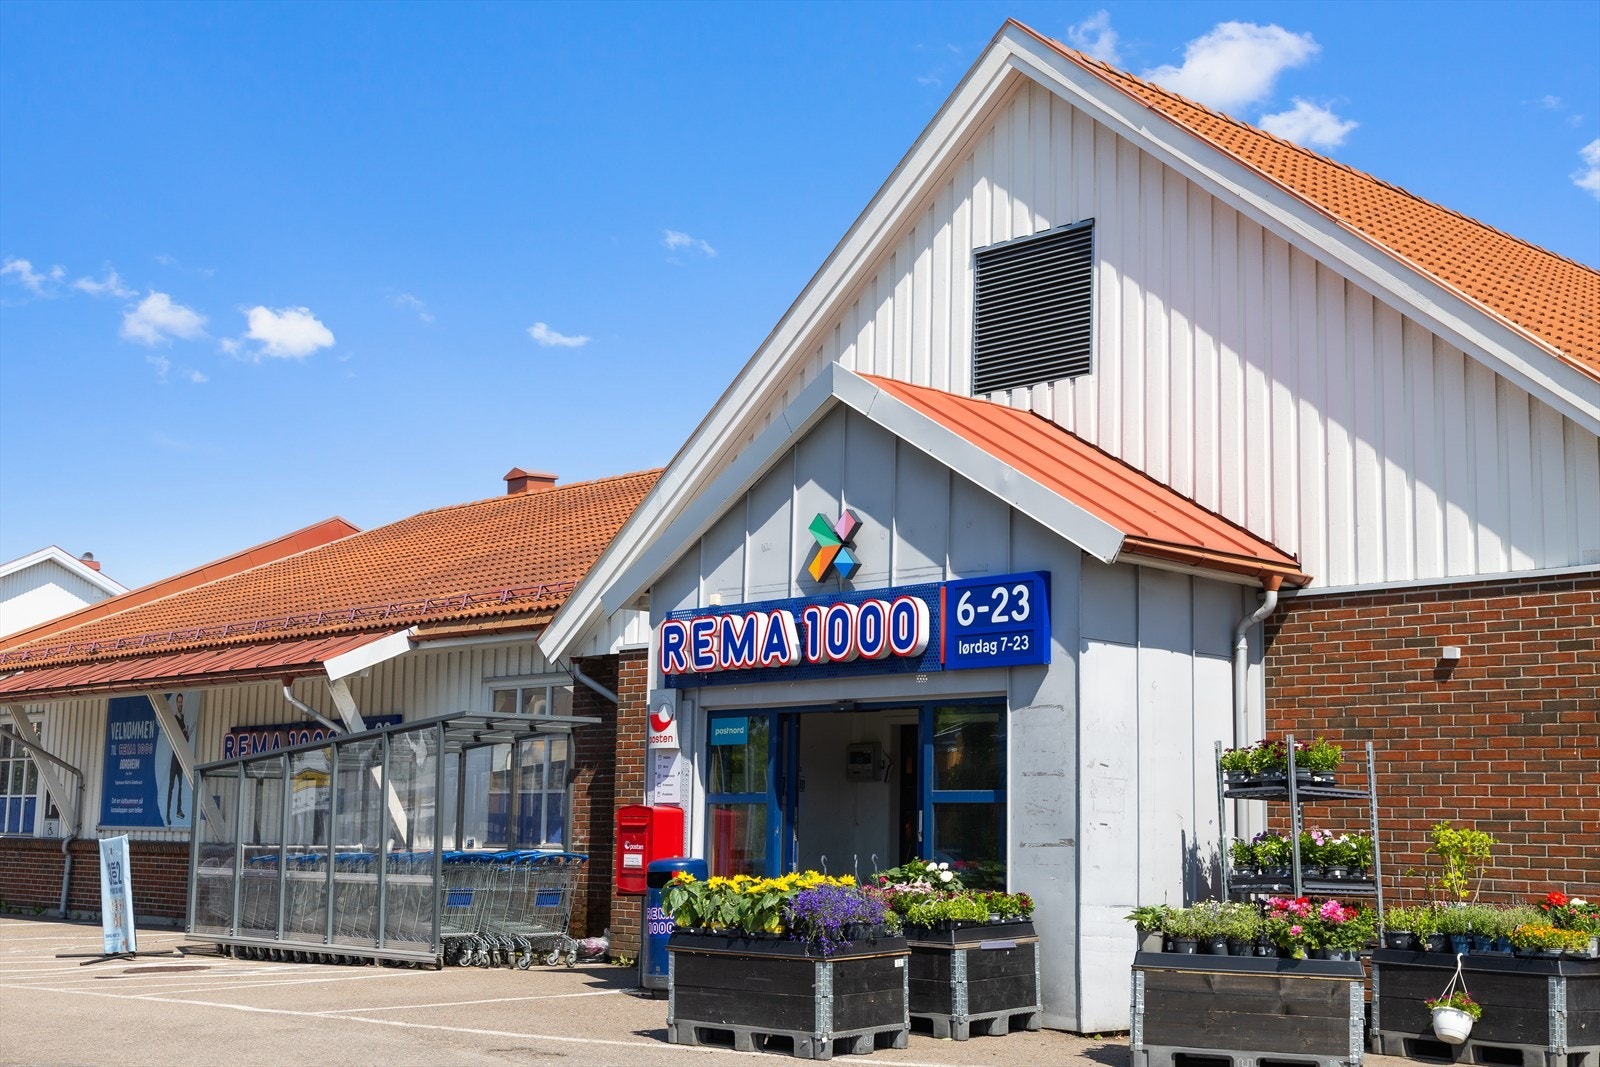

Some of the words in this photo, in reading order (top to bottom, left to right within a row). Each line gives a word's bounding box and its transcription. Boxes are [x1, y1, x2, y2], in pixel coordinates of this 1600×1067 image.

[956, 584, 1030, 626] 6-23
[659, 610, 792, 674] REMA
[802, 595, 920, 664] 1000
[958, 639, 998, 655] lørdag
[1000, 635, 1030, 651] 7-23
[110, 720, 155, 740] VELKOMMEN
[715, 726, 744, 736] postnord
